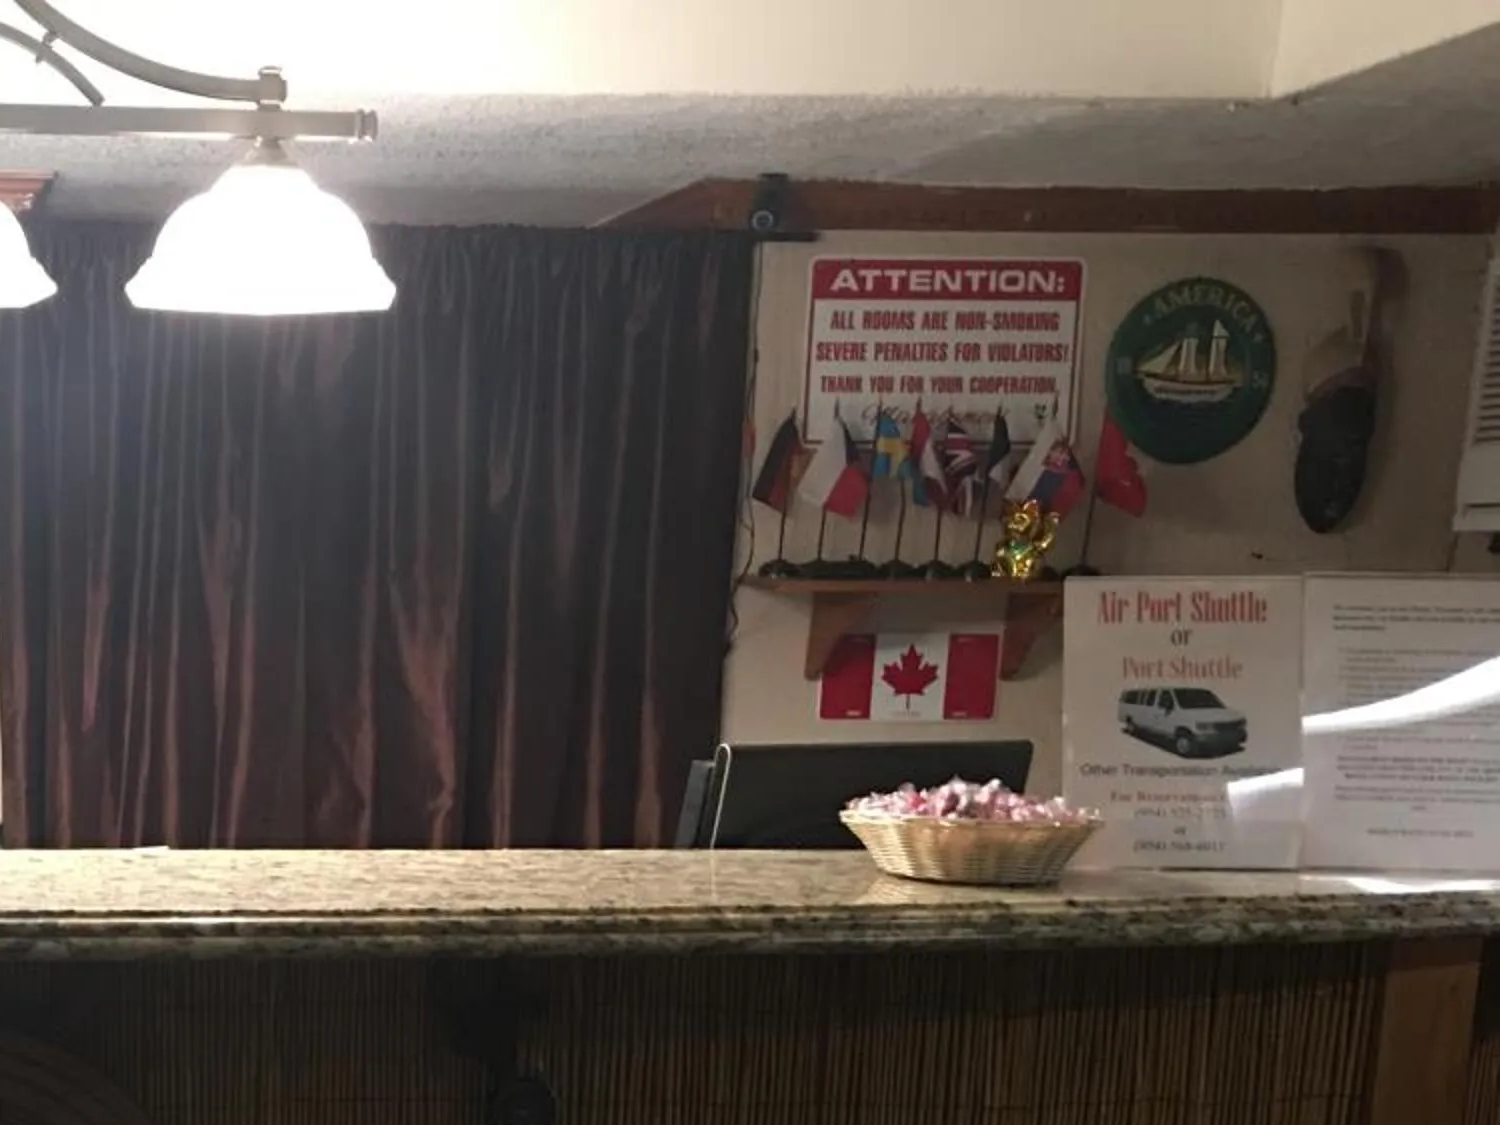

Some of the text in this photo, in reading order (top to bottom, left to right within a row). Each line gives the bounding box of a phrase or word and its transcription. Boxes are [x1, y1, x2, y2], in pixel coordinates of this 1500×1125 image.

[830, 269, 1065, 293] ATTENTION:
[830, 310, 1061, 331] ALL ROOMS ARE NON-SMOKING
[816, 342, 868, 362] SEVERE
[873, 342, 949, 362] PENALTIES
[954, 342, 981, 362] FOR
[820, 375, 864, 393] THANK
[869, 375, 895, 393] YOU
[900, 375, 925, 393] FOR
[930, 375, 964, 393] YOUR
[1098, 591, 1268, 624] Air Port Shuttle
[1169, 628, 1193, 647] or
[1122, 655, 1244, 680] Port Shuttle
